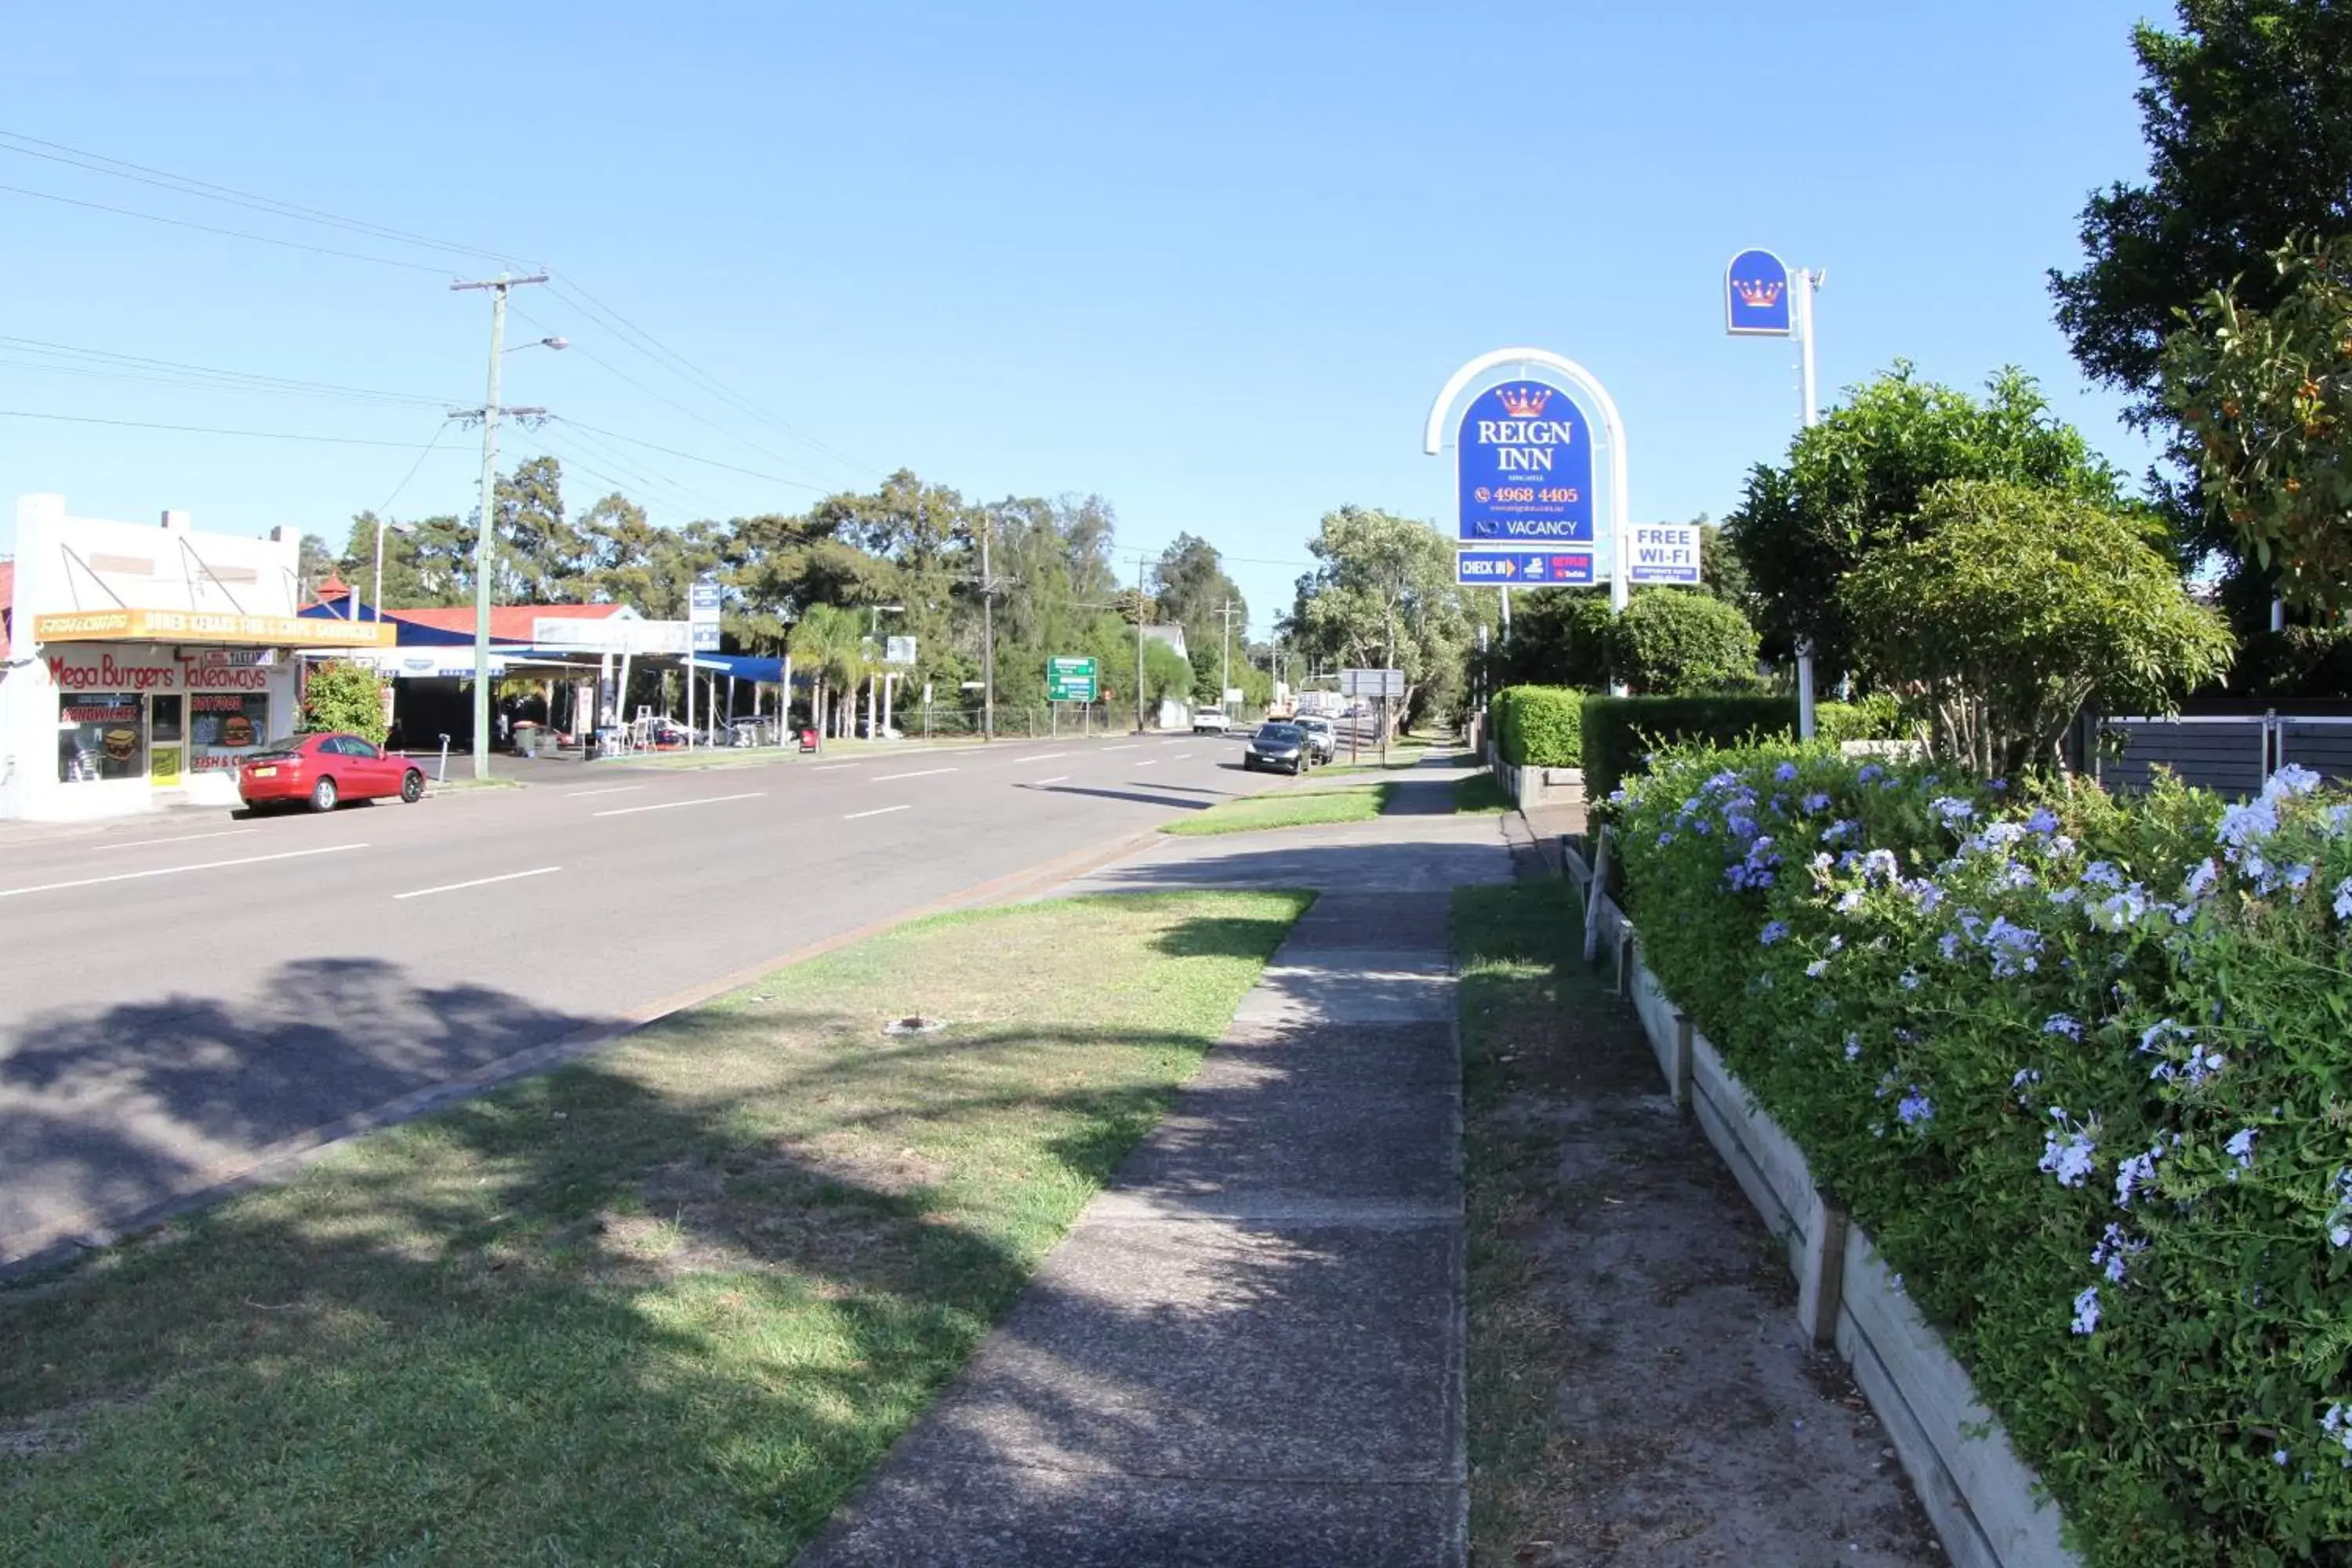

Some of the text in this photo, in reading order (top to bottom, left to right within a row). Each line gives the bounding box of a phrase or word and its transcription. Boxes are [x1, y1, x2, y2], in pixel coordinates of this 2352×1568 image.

[1477, 421, 1573, 445] REIGN
[1497, 448, 1553, 470] INN
[1493, 487, 1578, 503] 4968 4405
[1506, 521, 1577, 535] VACANCY
[1637, 529, 1690, 544] FREE
[1639, 548, 1690, 563] WI-FI
[1462, 561, 1506, 575] CHECK IN
[49, 655, 98, 689] Mega
[102, 653, 174, 690] Burgers
[183, 655, 267, 690] Takeaways
[195, 756, 220, 768] FISH
